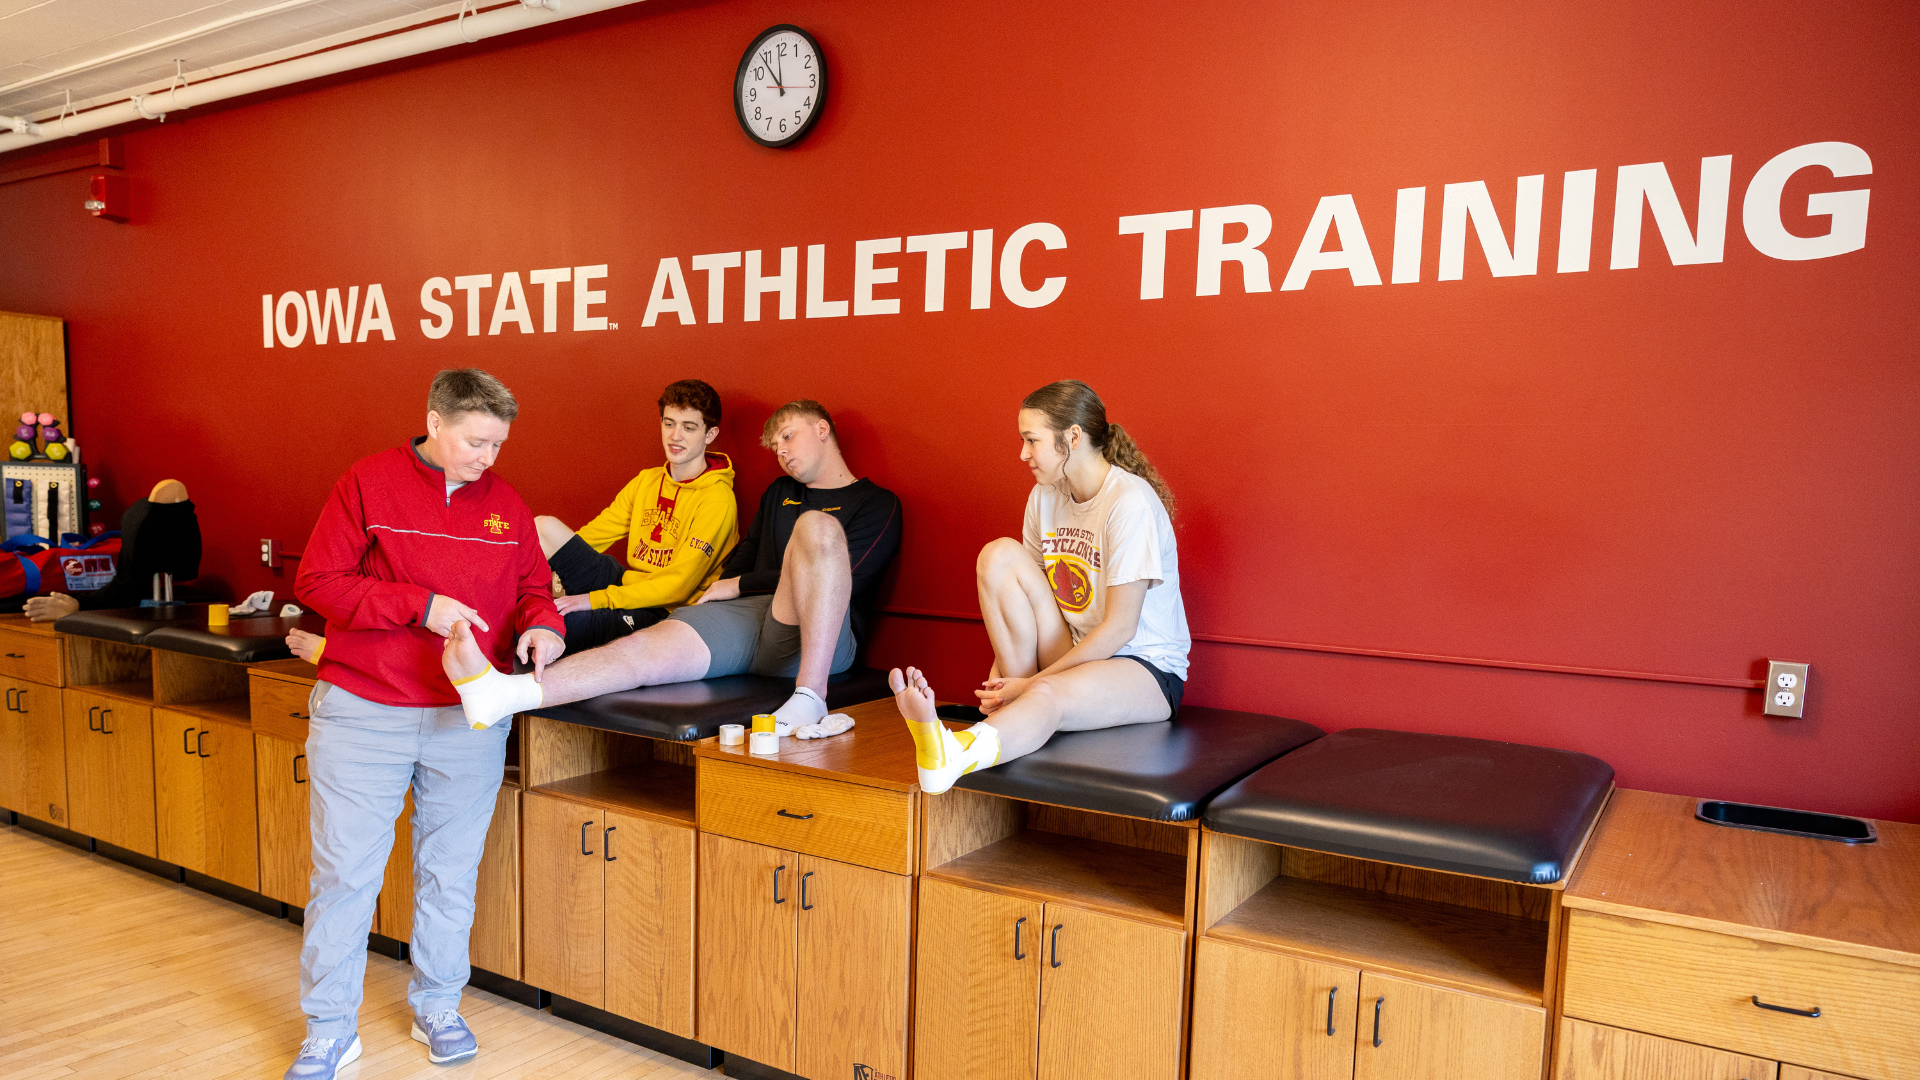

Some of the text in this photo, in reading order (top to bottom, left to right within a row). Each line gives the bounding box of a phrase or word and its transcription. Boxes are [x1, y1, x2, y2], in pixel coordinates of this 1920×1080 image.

[763, 50, 772, 64] 11
[776, 42, 787, 57] 12
[793, 43, 798, 58] 1
[804, 54, 812, 69] 2
[753, 66, 764, 81] 10
[809, 73, 816, 89] 3
[749, 88, 757, 102] 9
[803, 95, 811, 110] 4
[754, 106, 762, 121] 8
[794, 110, 802, 125] 5
[765, 116, 773, 131] 7
[779, 118, 787, 133] 6
[261, 283, 396, 349] IOWA
[419, 263, 608, 340] STATE
[641, 222, 1068, 328] ATHLETIC
[1118, 141, 1873, 301] TRAINING
[484, 520, 509, 529] STATE
[1056, 528, 1080, 538] IOWA
[1041, 539, 1100, 567] CYCLONES
